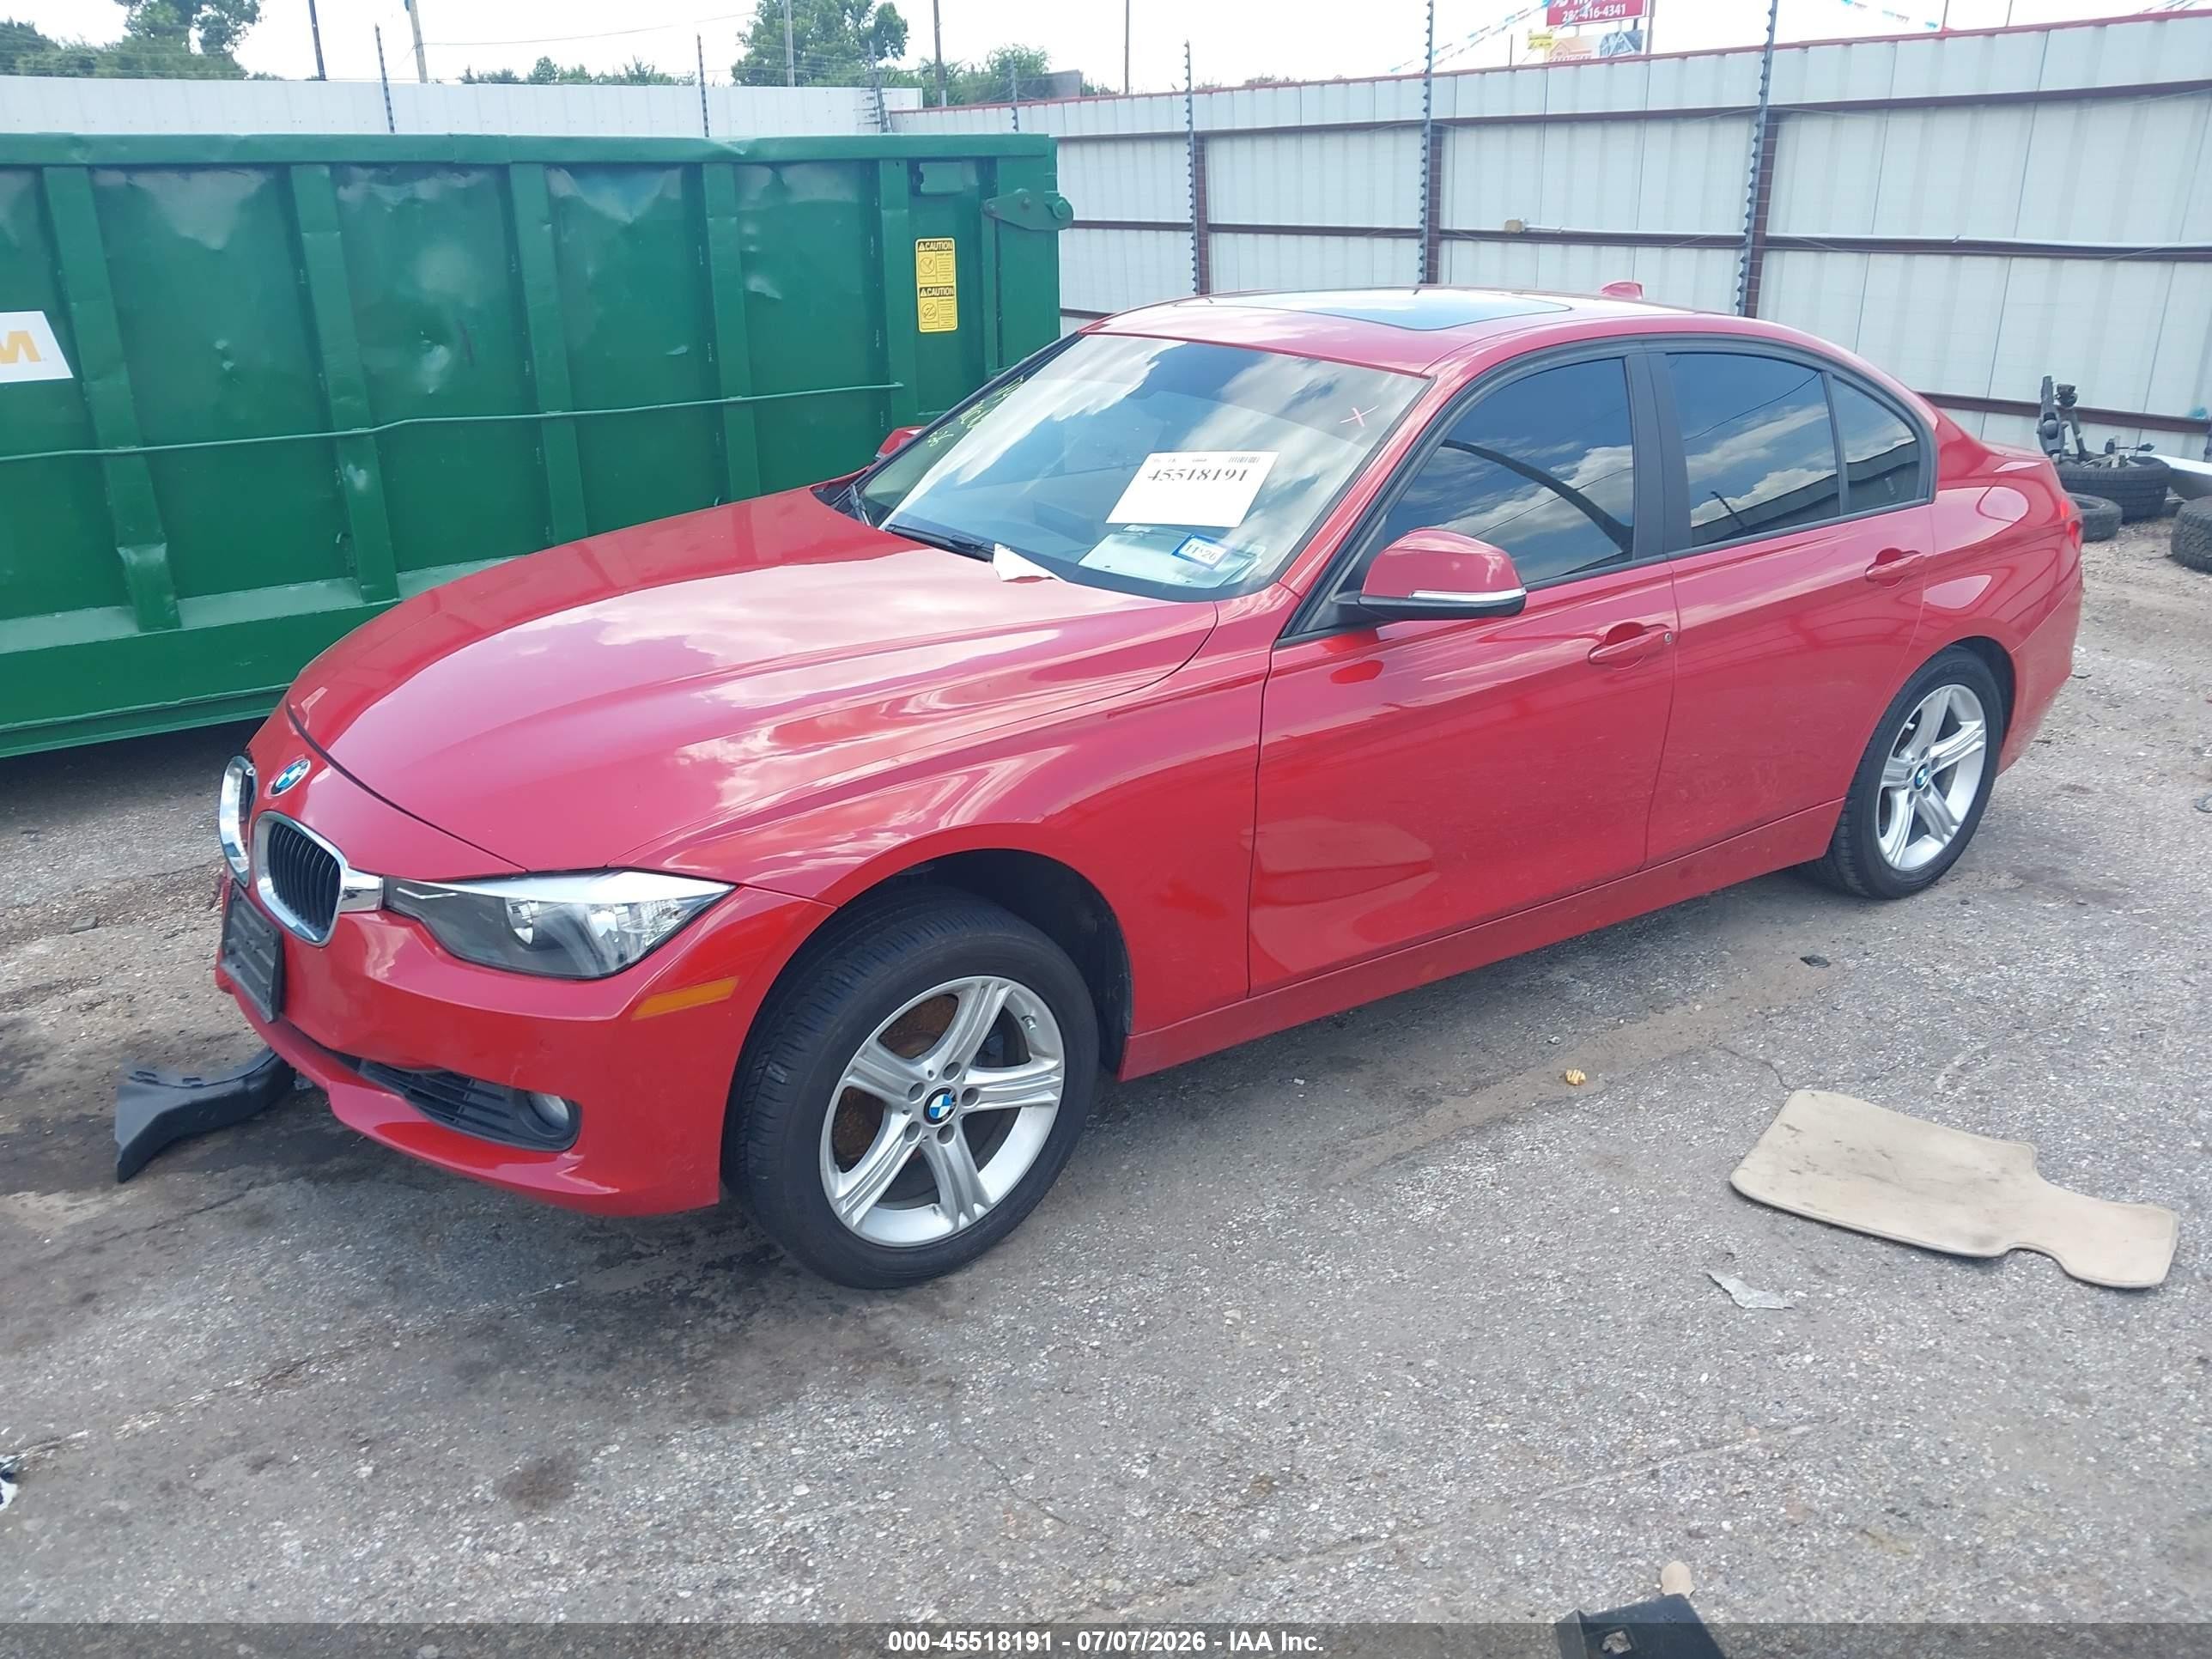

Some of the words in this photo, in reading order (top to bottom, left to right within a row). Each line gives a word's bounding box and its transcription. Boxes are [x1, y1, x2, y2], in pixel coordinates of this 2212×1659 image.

[925, 241, 953, 252] CAUTION
[927, 287, 954, 296] CAUTION
[1147, 469, 1249, 482] 45518191
